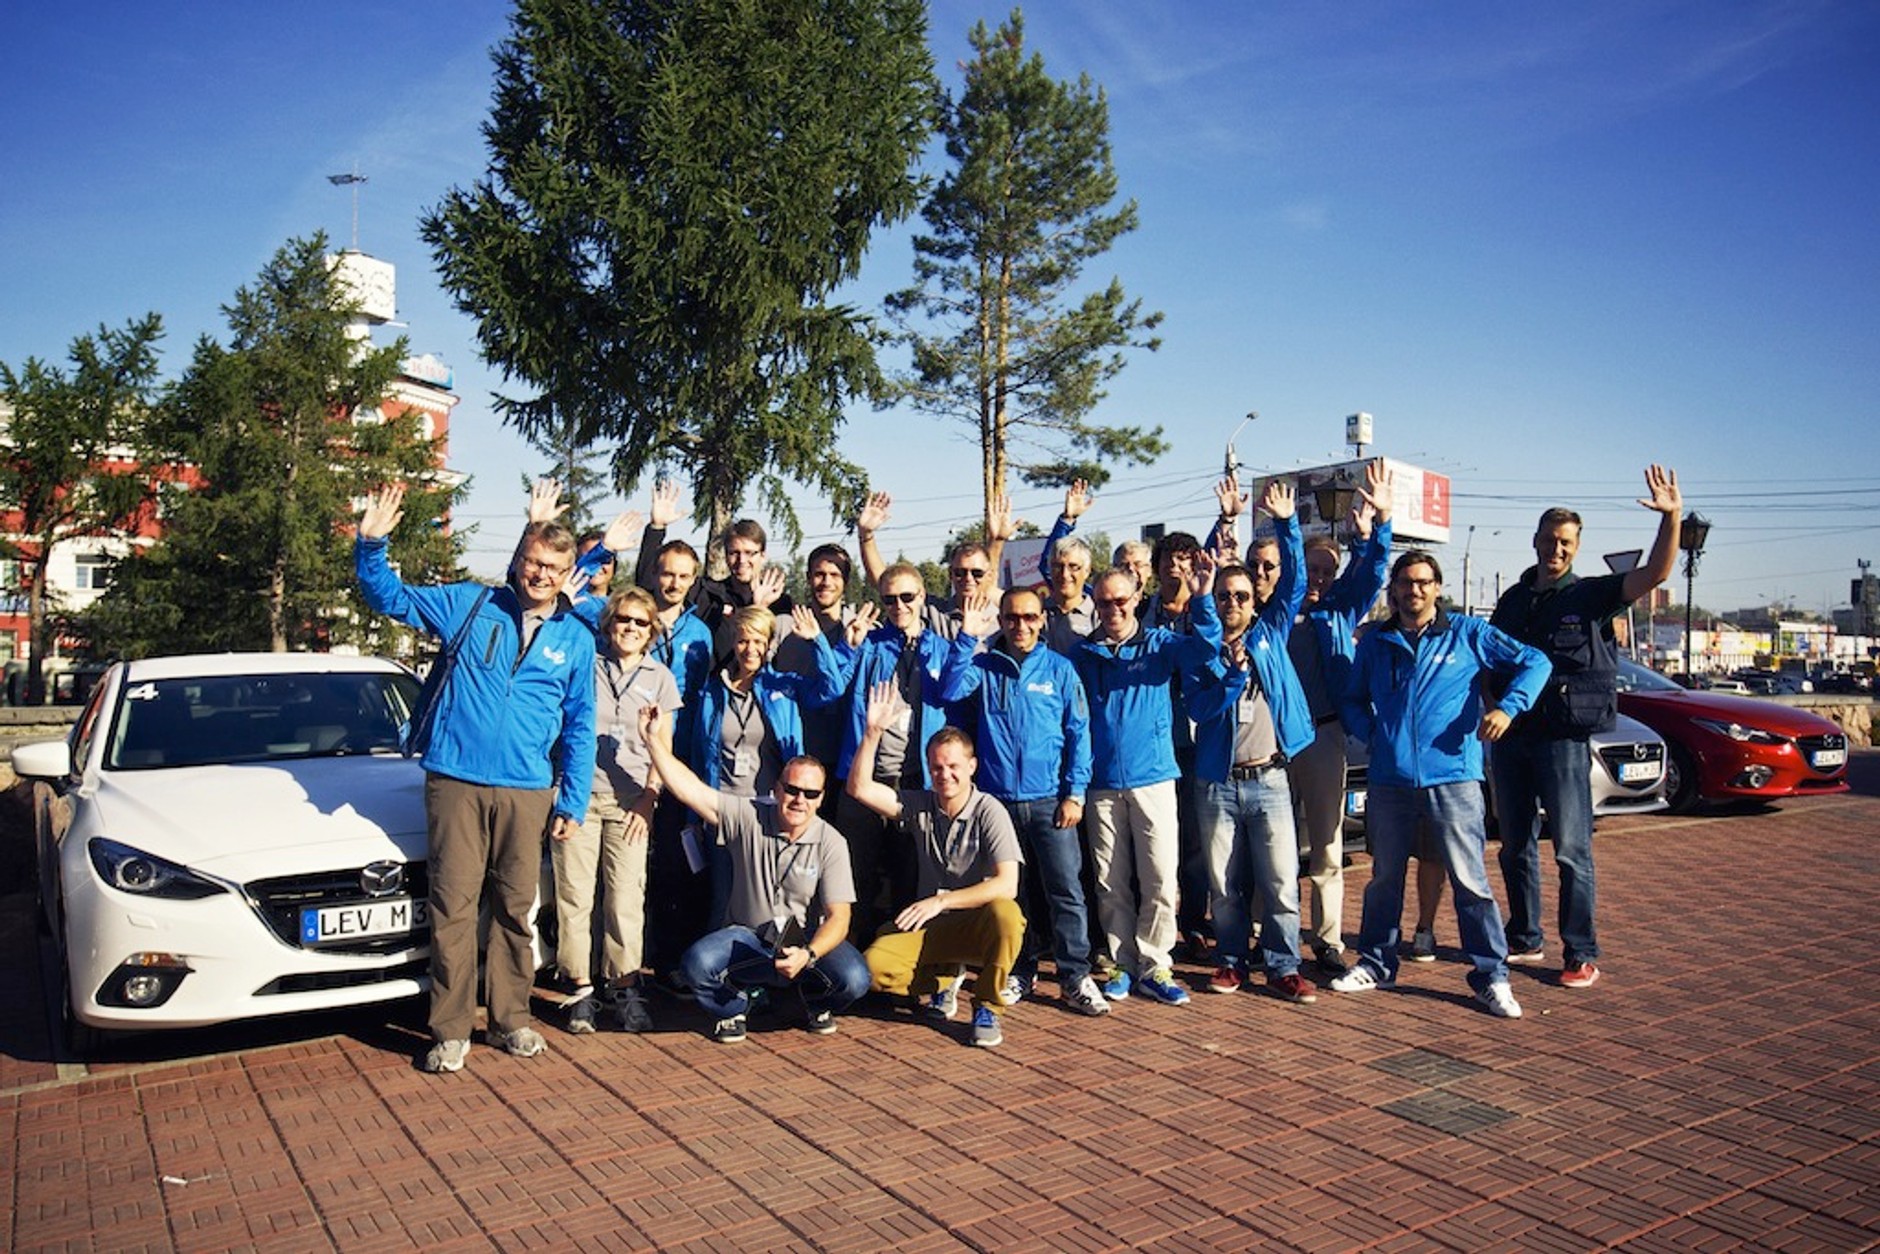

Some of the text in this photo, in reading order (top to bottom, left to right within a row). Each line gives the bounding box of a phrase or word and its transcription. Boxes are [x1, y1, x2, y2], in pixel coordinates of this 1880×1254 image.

[126, 682, 159, 700] 4
[321, 909, 372, 936] LEV
[391, 904, 406, 928] M
